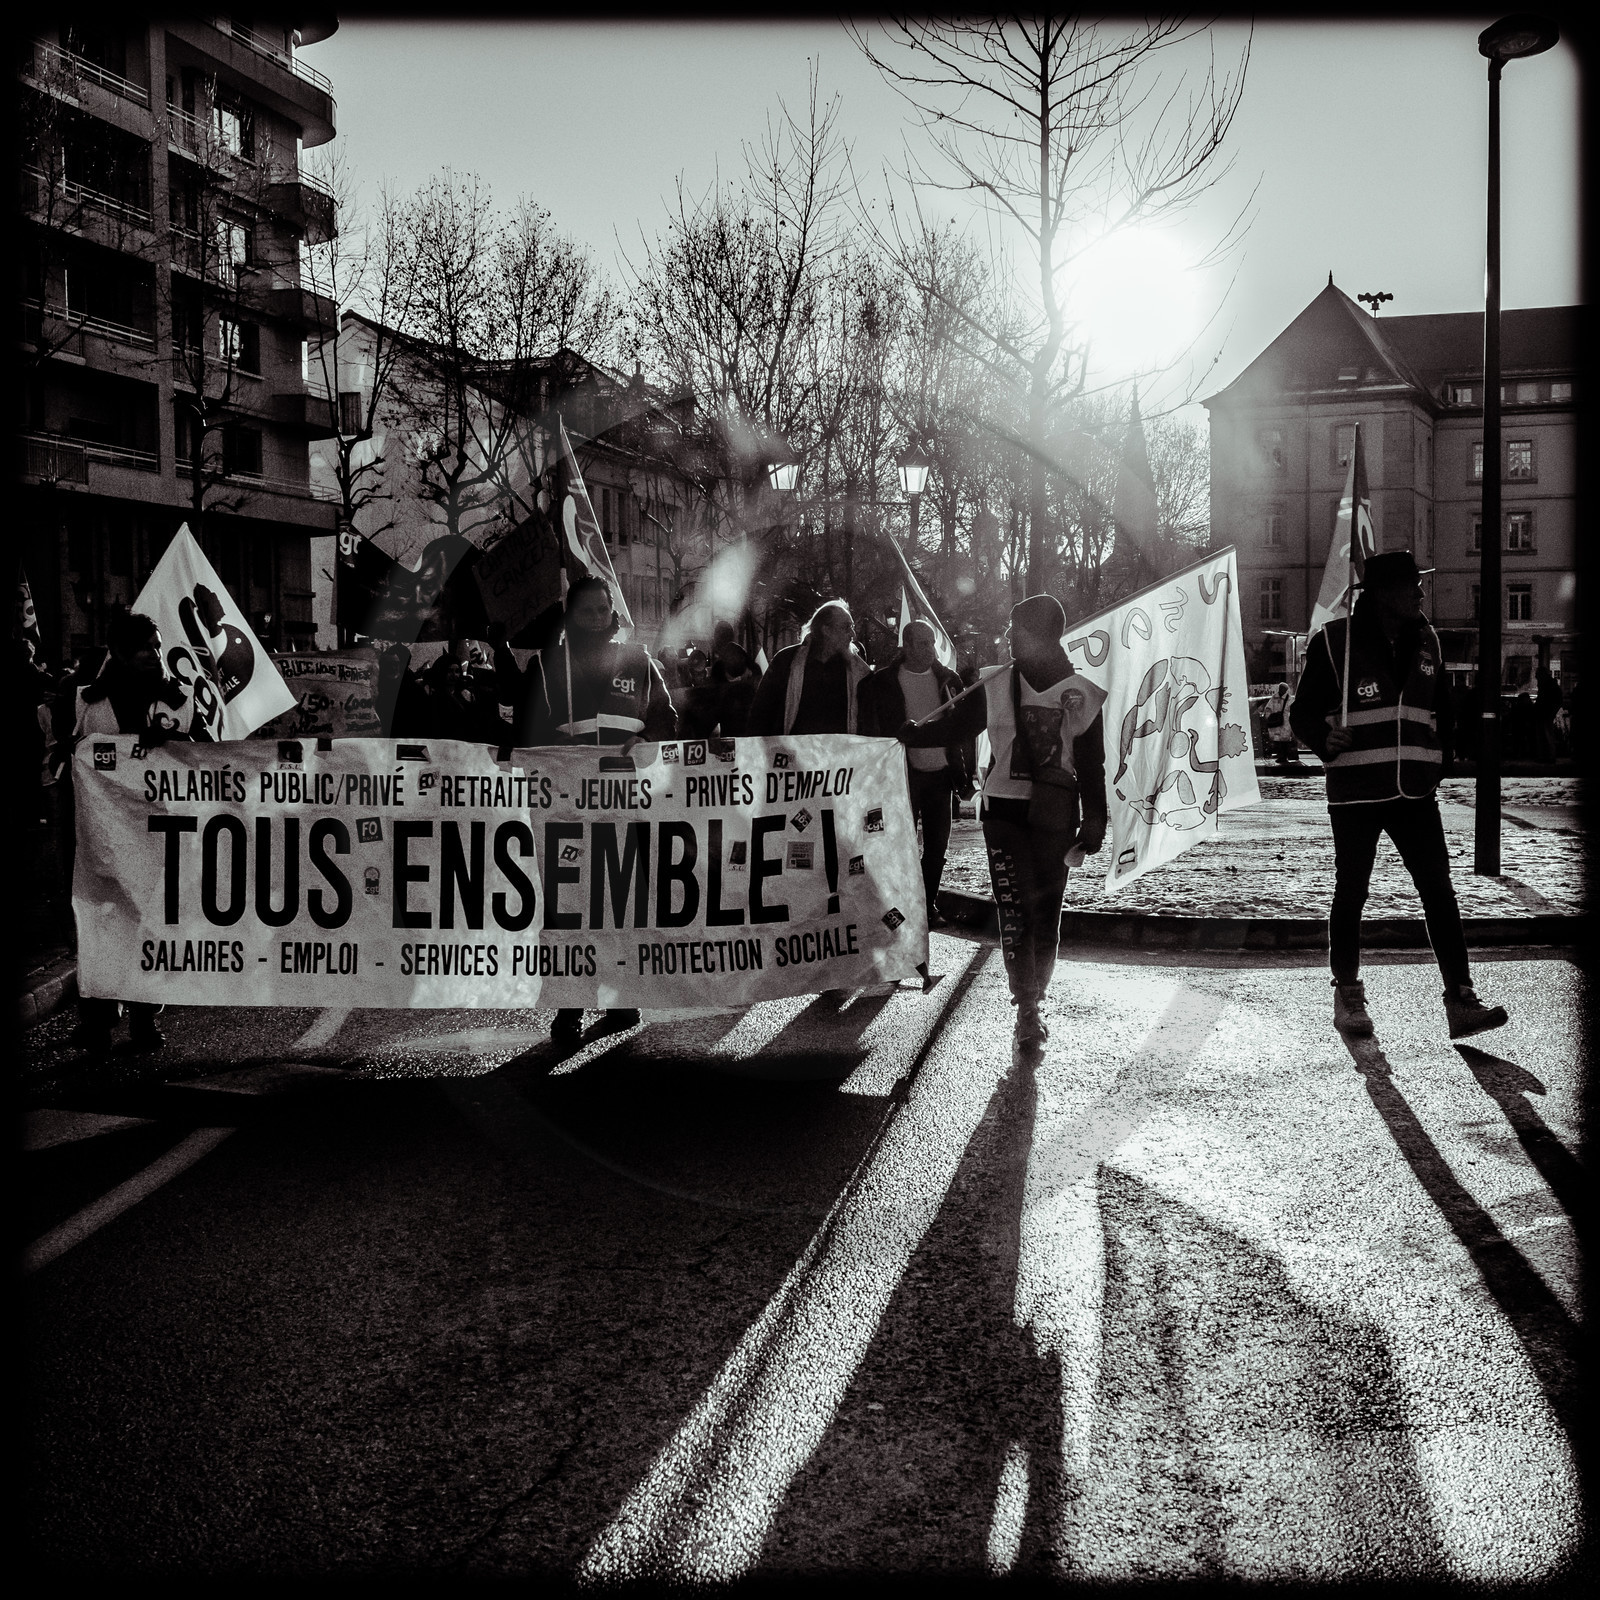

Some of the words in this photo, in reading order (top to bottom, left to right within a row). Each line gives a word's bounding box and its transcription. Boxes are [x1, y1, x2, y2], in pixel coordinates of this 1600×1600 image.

[339, 531, 362, 555] gt
[612, 677, 636, 694] cgt
[1357, 681, 1380, 697] cgt
[94, 750, 116, 764] cgt
[687, 744, 704, 760] FO
[144, 764, 246, 803] SALARIÉS
[260, 766, 404, 806] PUBLIC/PRIVÉ
[441, 771, 552, 809] RETRAITÉS
[575, 778, 652, 810] JEUNES
[686, 768, 754, 807] PRIVÉS
[766, 768, 854, 804] D'EMPLOI
[361, 820, 378, 837] FO
[867, 819, 885, 831] cgt
[148, 813, 353, 930] TOUS
[392, 814, 790, 932] ENSEMBLE
[140, 939, 245, 974] SALAIRES
[280, 942, 358, 975] EMPLOI
[400, 944, 499, 977] SERVICES
[512, 944, 597, 977] PUBLICS
[638, 938, 763, 976] PROTECTION
[775, 924, 860, 968] SOCIALE
